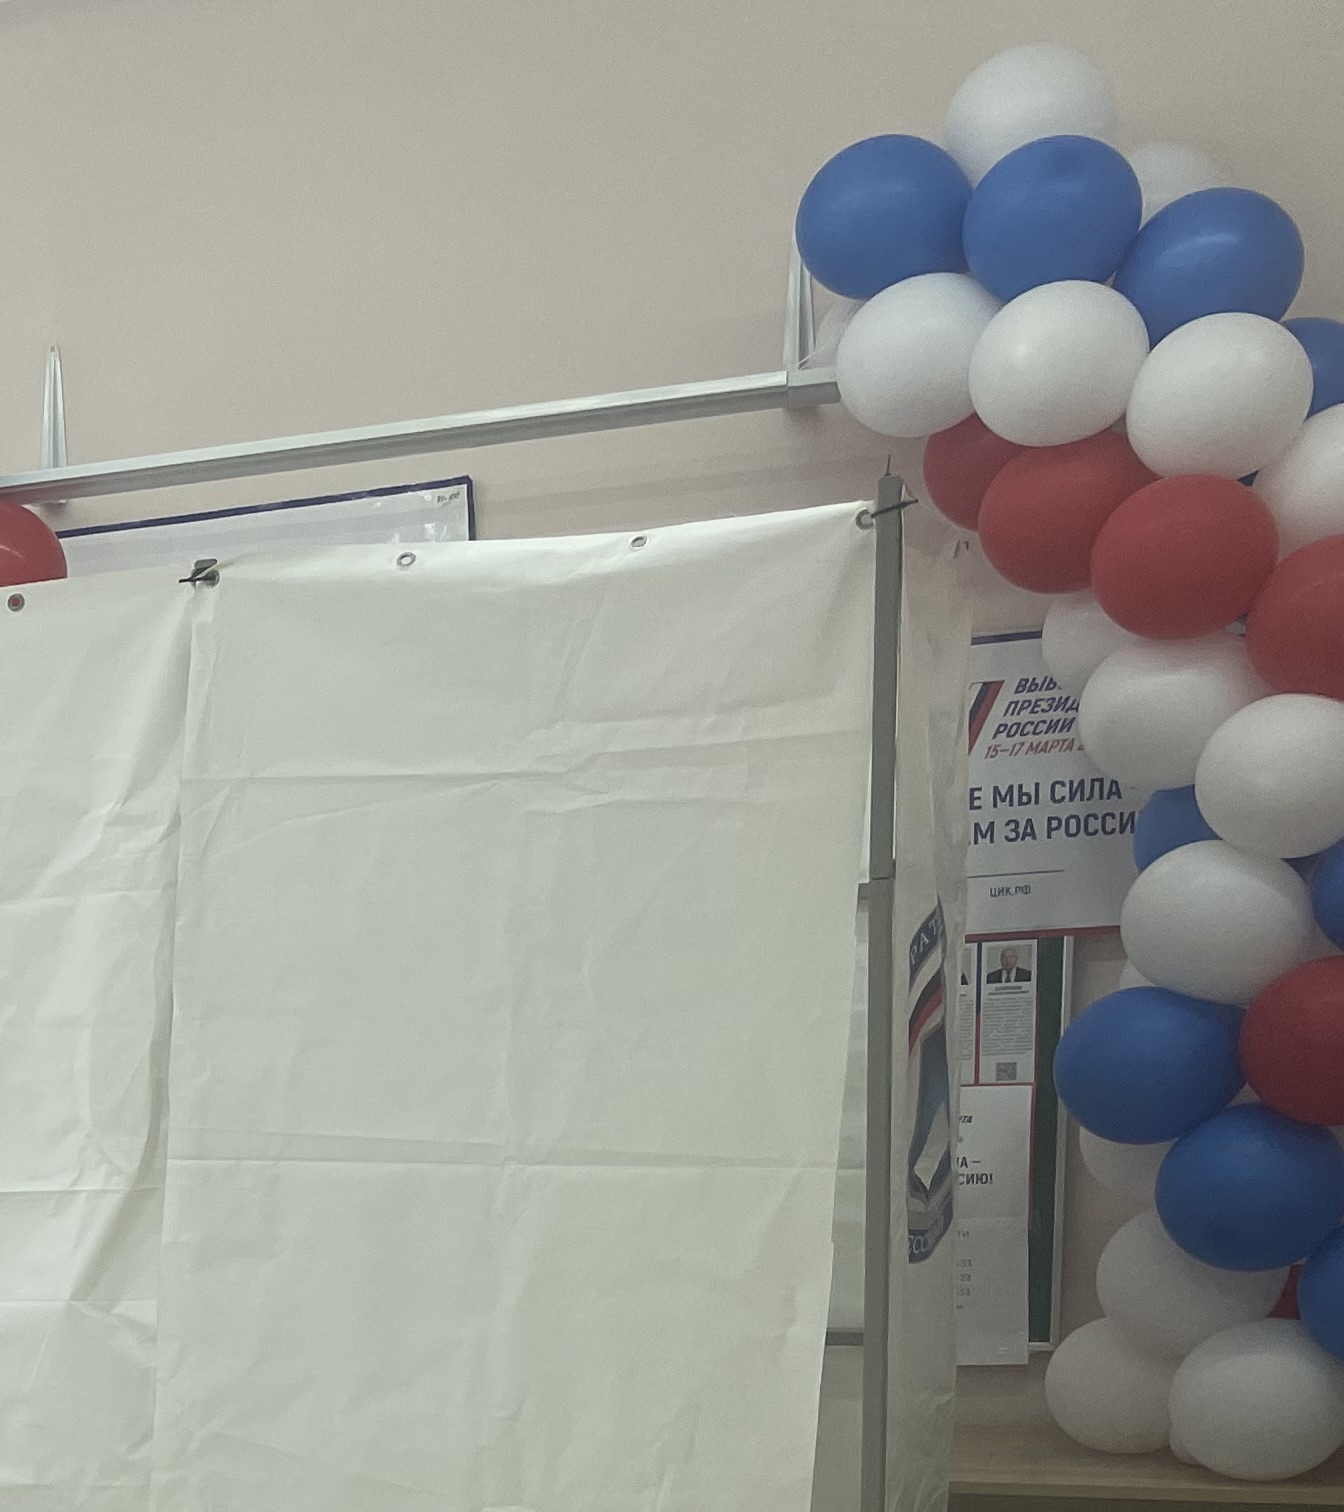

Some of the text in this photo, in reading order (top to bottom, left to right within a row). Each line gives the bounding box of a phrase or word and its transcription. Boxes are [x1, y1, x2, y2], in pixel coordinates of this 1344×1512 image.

[1014, 676, 1062, 694] ВЫБ
[992, 717, 1076, 740] РОССИИ
[1025, 738, 1075, 755] МАРТА
[993, 782, 1040, 808] МЫ
[1050, 778, 1123, 804] СИЛА
[968, 810, 1141, 845] М ЗА РОССИ
